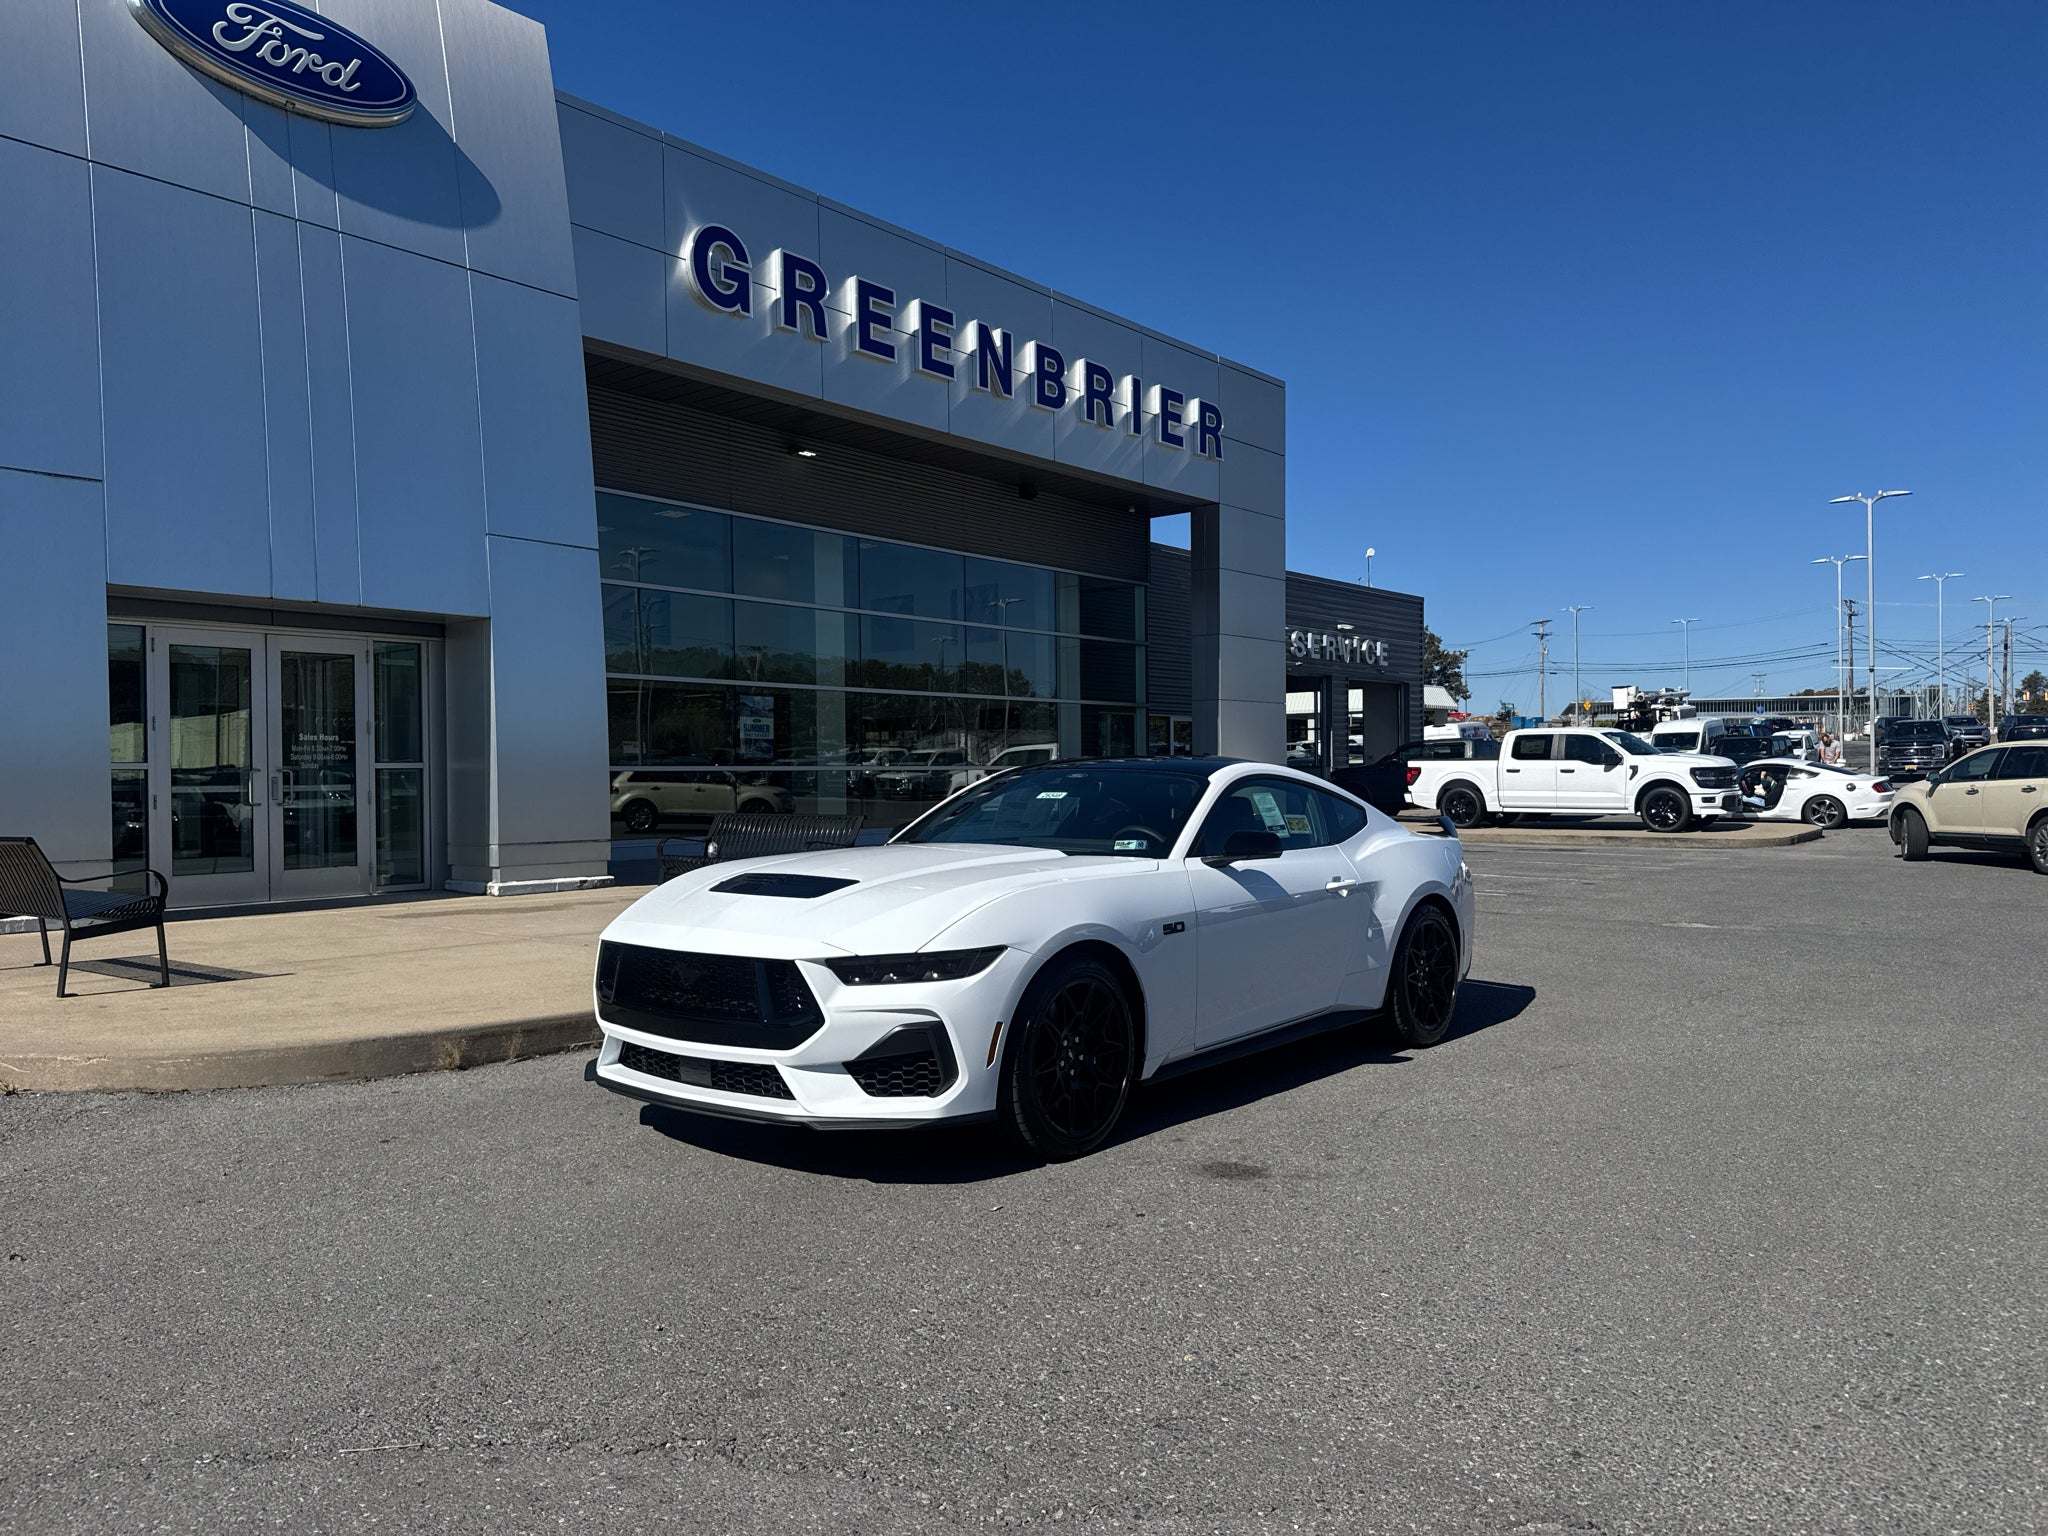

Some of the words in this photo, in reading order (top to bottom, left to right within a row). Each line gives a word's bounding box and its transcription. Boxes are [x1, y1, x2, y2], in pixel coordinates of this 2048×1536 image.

[213, 3, 361, 91] Ford
[686, 223, 1224, 461] GREENBRIER
[1291, 630, 1389, 666] SERVICE
[299, 733, 317, 741] Sales
[319, 733, 339, 741] Hours
[290, 753, 312, 761] Saturday
[301, 762, 319, 771] Sunday
